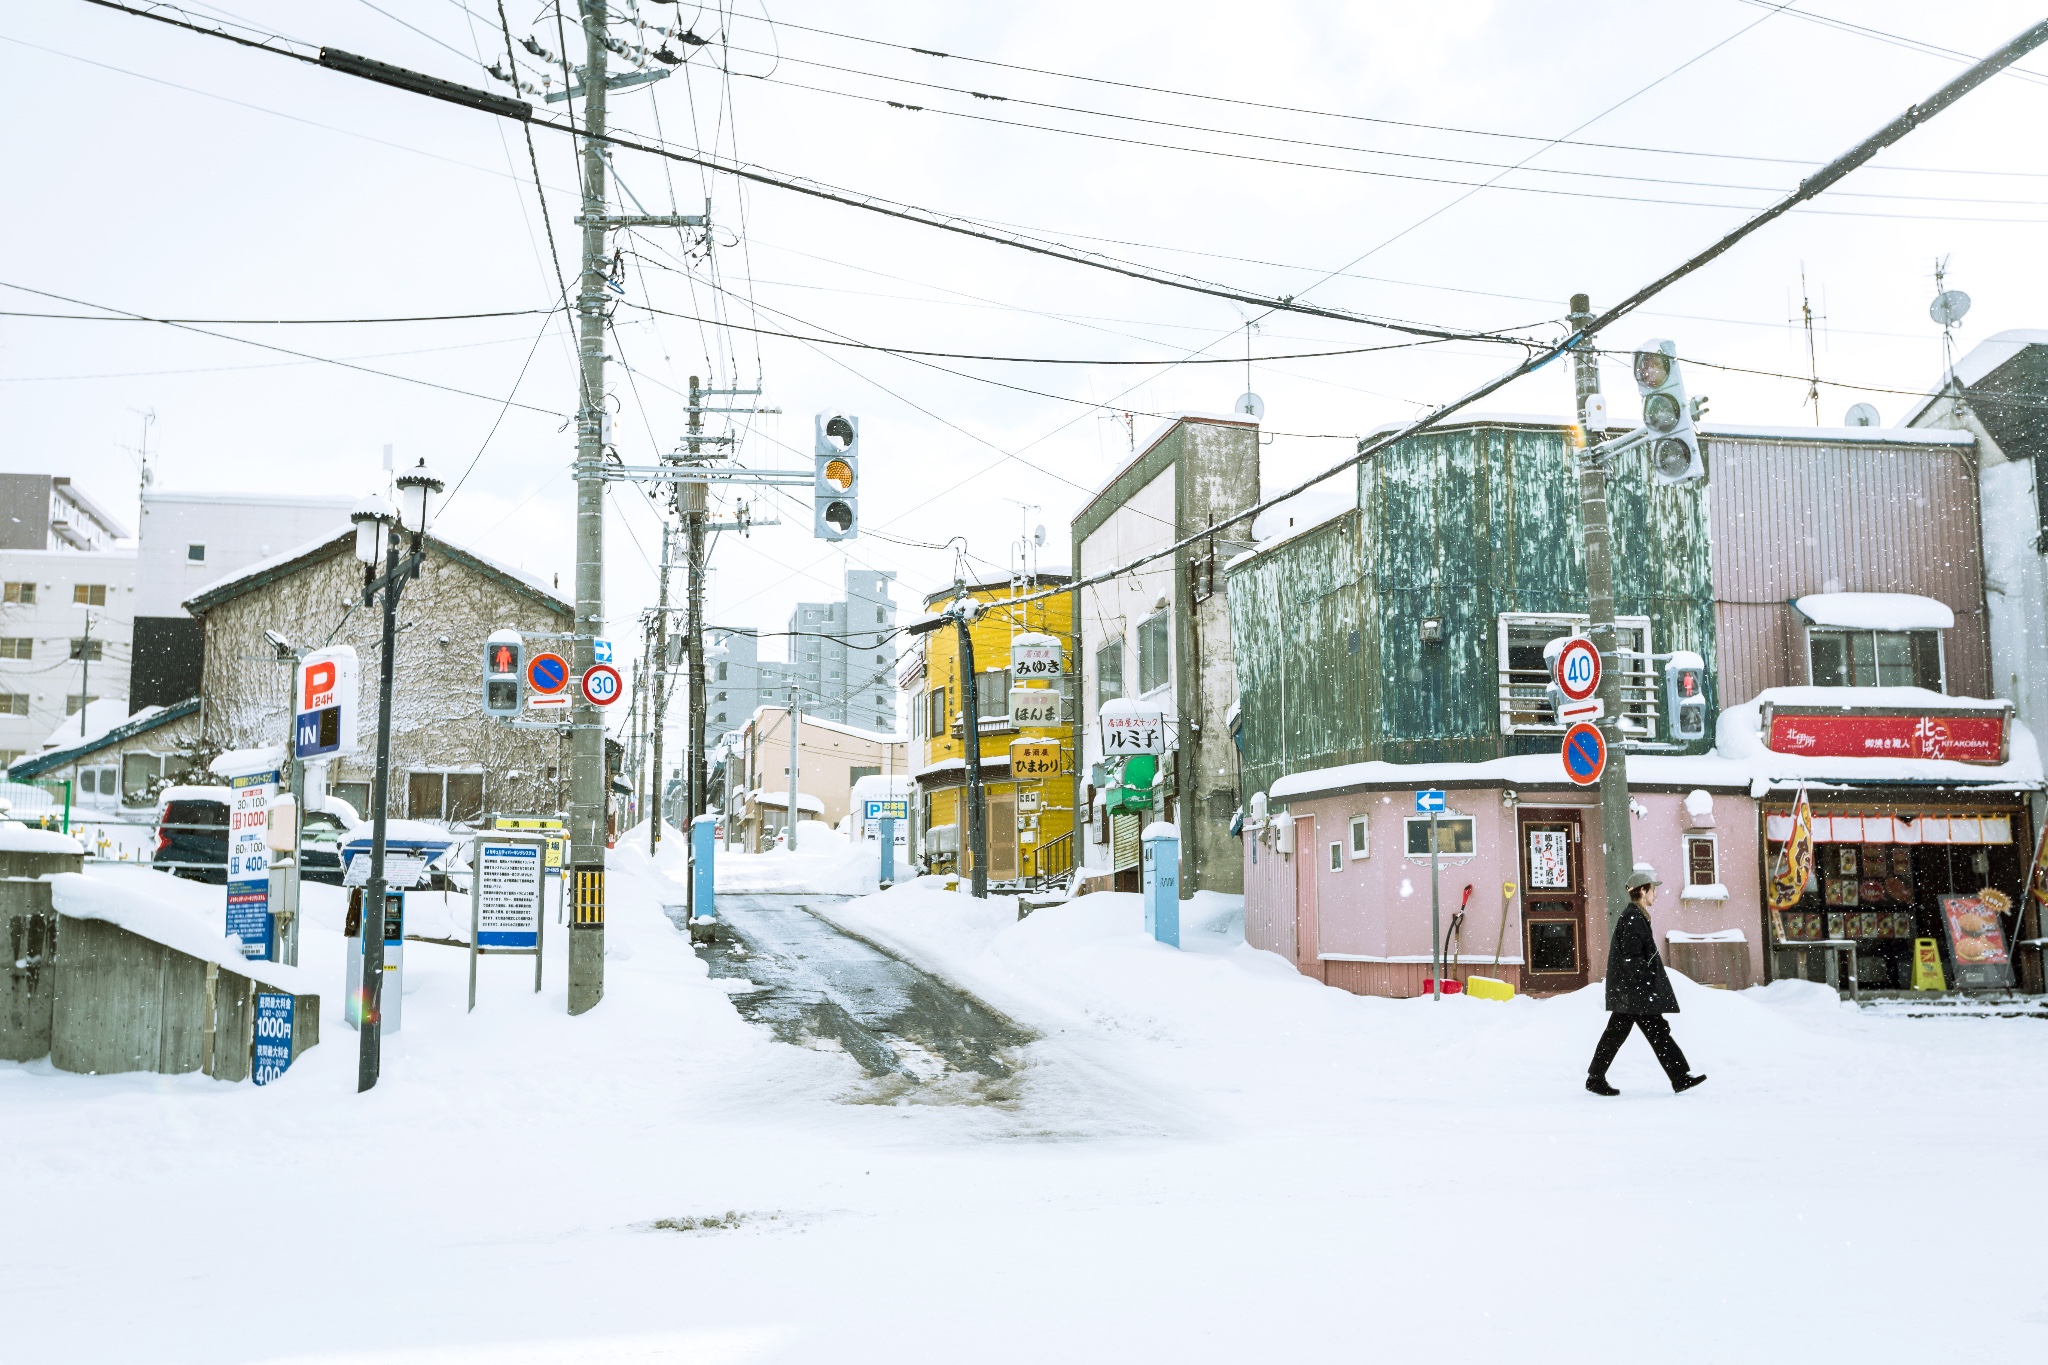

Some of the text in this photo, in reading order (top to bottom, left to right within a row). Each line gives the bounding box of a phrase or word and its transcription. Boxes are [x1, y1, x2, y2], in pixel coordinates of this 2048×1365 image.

[1016, 660, 1060, 675] みゆき
[1568, 656, 1590, 683] 40
[304, 661, 335, 710] P
[592, 677, 614, 694] 30
[314, 693, 334, 708] 24H
[1015, 706, 1056, 721] ほんま
[1107, 718, 1158, 728] 居酒屋スナック
[299, 724, 317, 746] IN
[1110, 729, 1159, 748] ルミ子
[1941, 740, 1989, 748] KITAKOBAN
[1023, 748, 1050, 757] 居酒屋
[1015, 759, 1059, 773] ひまわり
[869, 804, 881, 817] P
[260, 997, 291, 1009] 昼間最大料金
[258, 1017, 291, 1039] 1000円
[257, 1045, 289, 1059] 夜間最大料金
